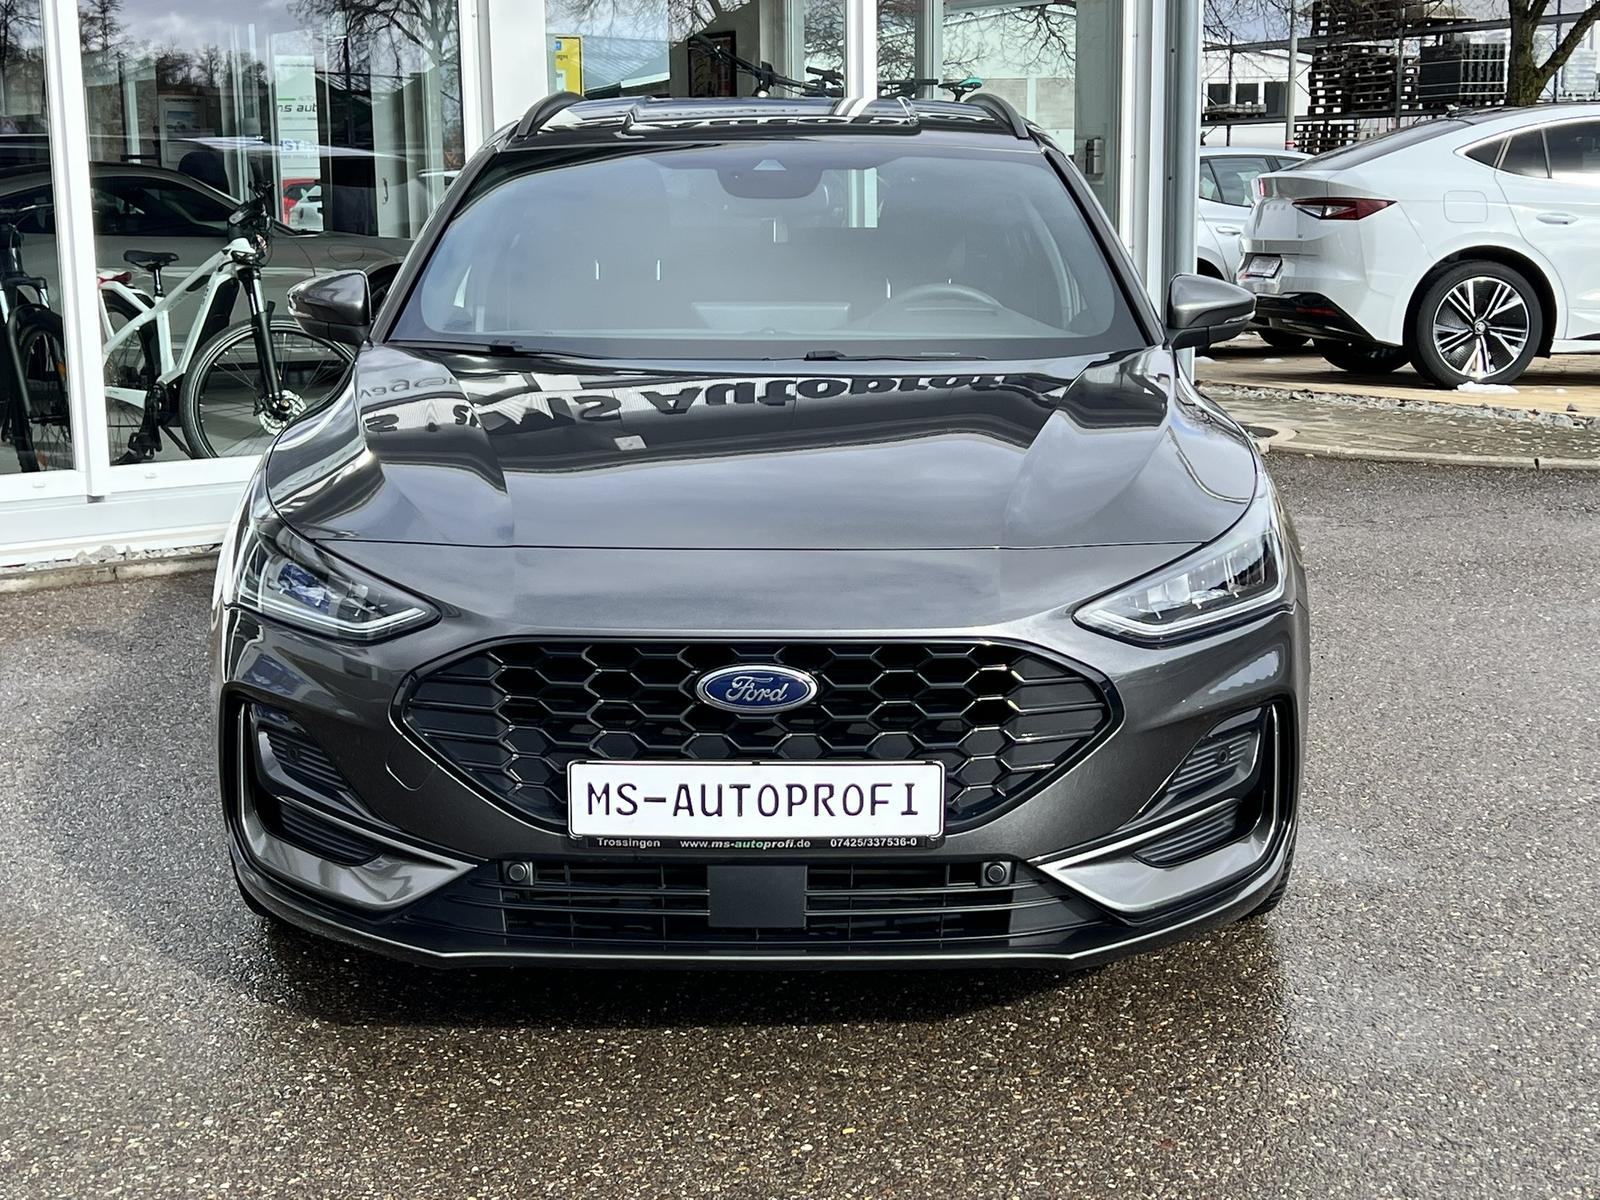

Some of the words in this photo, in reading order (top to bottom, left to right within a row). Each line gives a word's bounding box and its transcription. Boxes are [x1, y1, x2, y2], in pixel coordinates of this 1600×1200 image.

[725, 676, 789, 701] Ford
[587, 782, 918, 817] MS-AUTOPROFI
[597, 837, 661, 849] Trossingen
[680, 838, 811, 850] www.ms-autoprofi.de
[830, 837, 917, 848] 07425/337536-0
